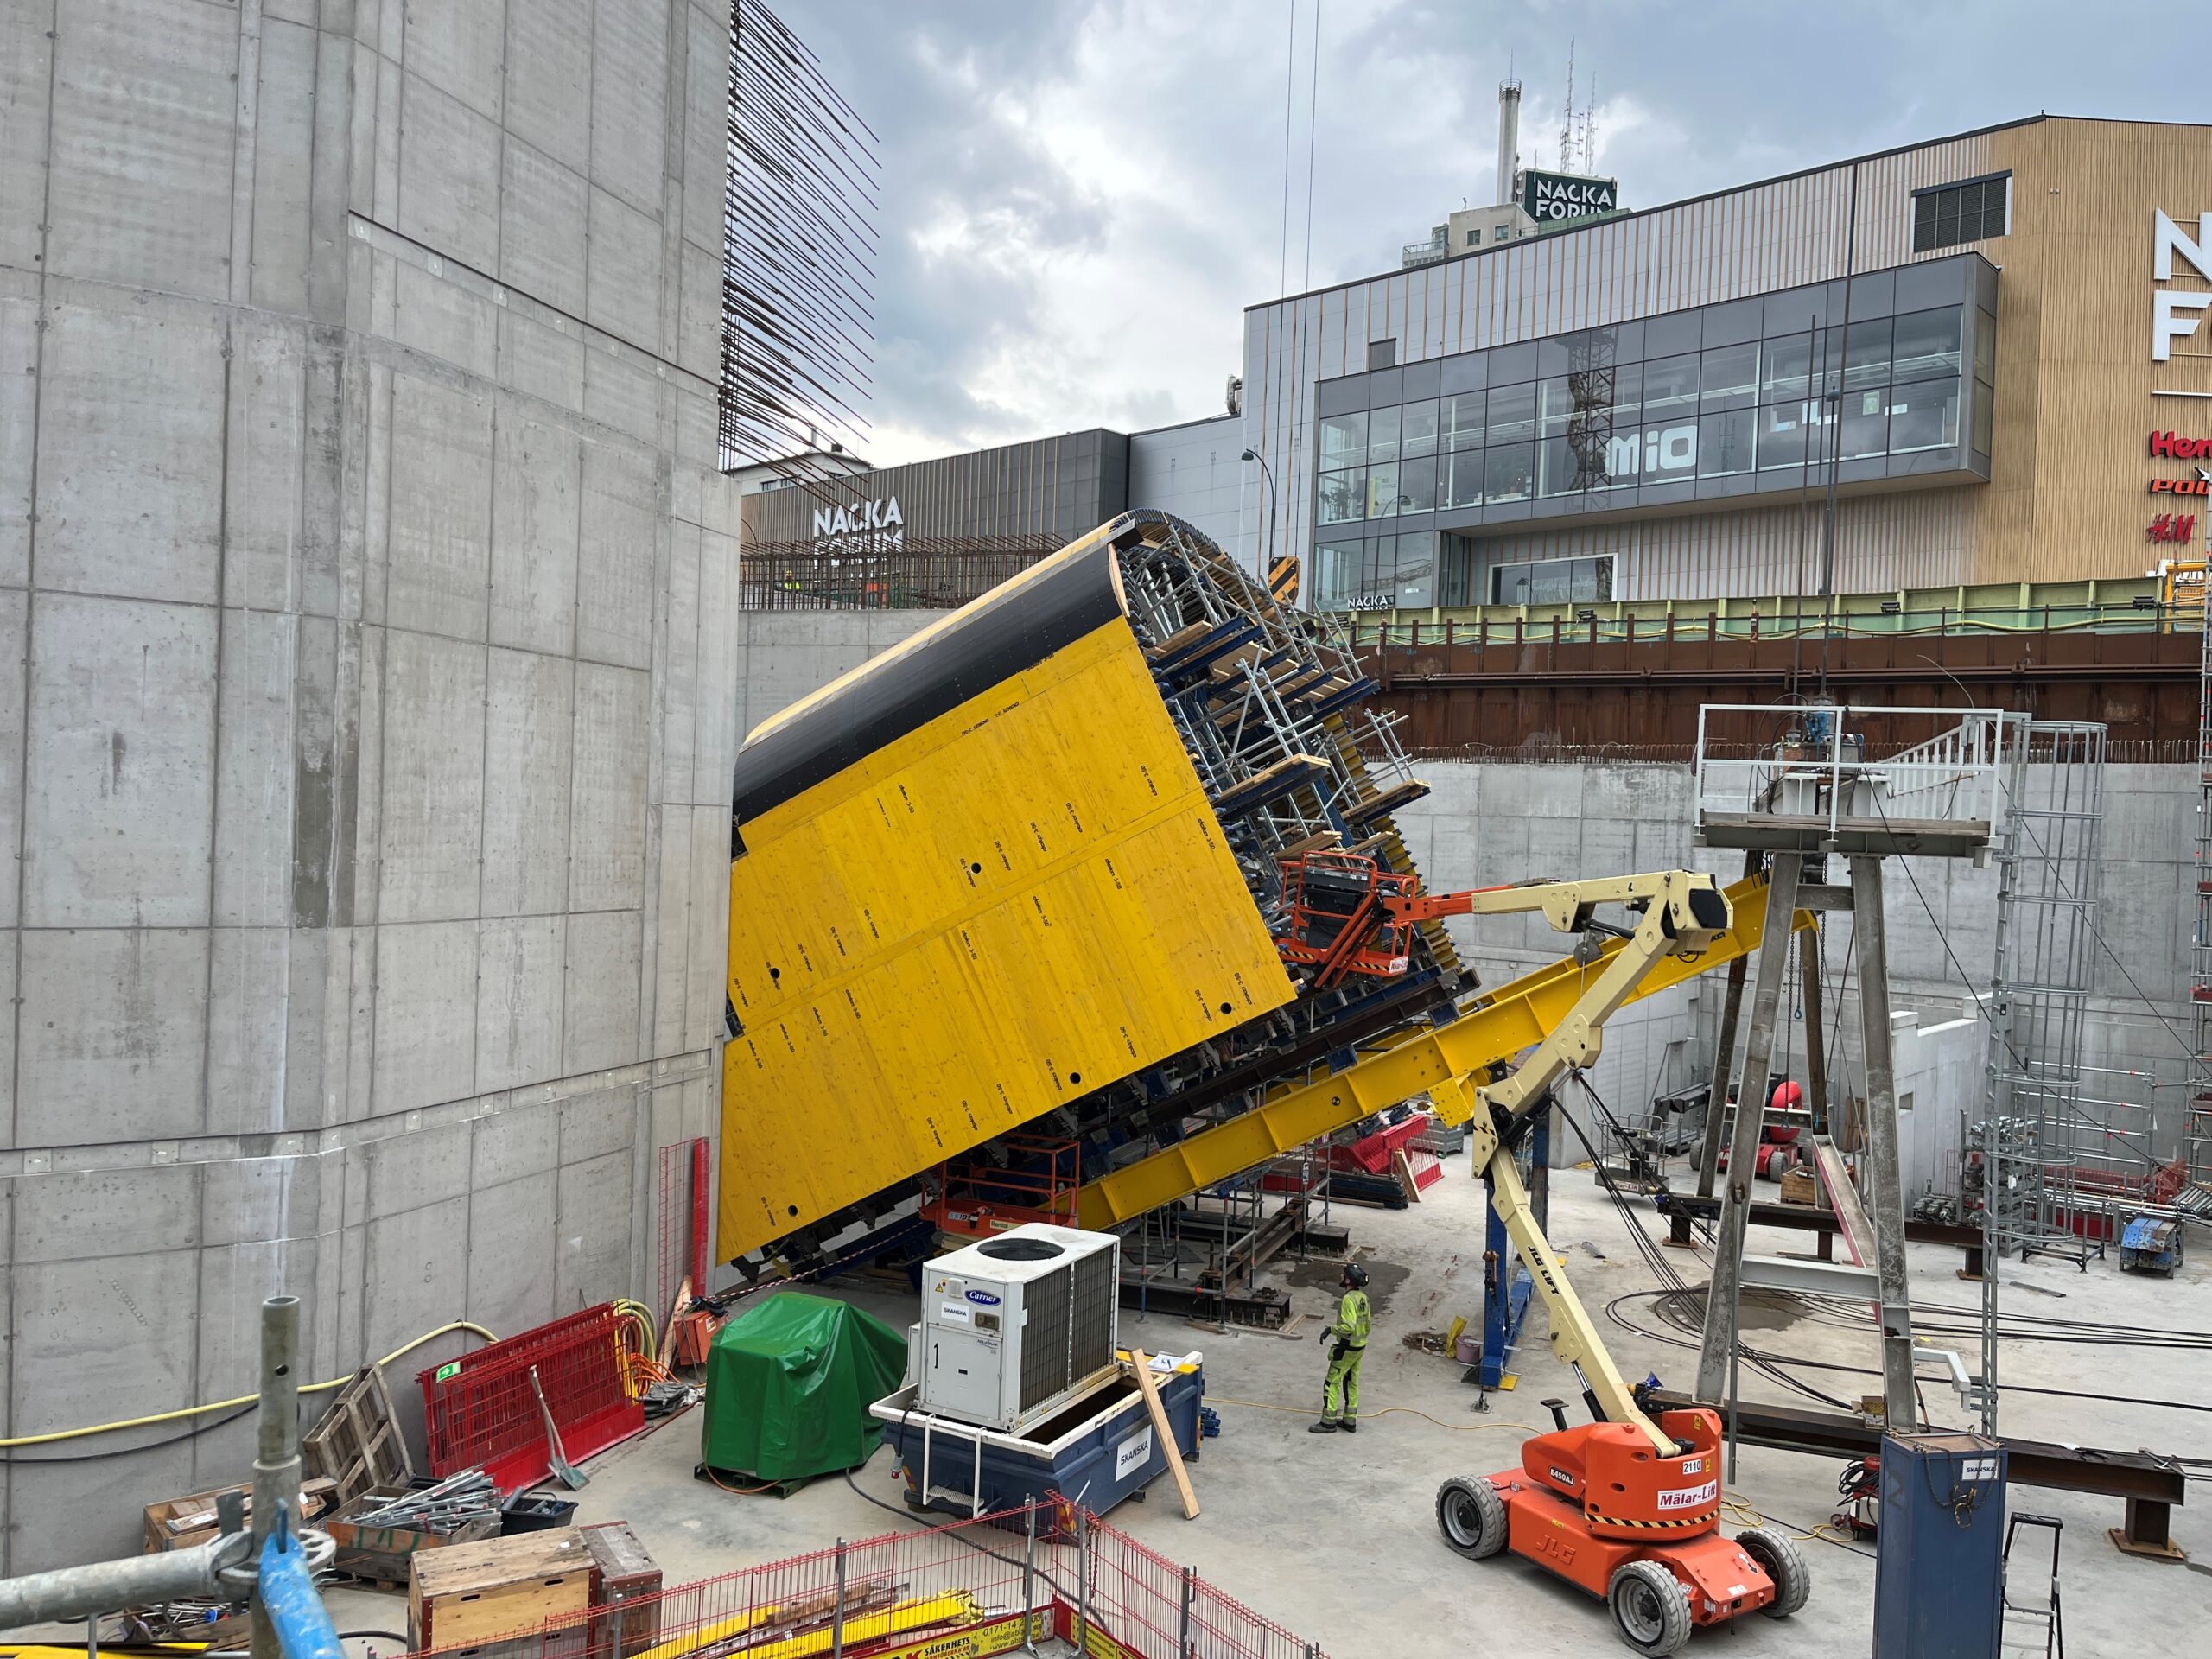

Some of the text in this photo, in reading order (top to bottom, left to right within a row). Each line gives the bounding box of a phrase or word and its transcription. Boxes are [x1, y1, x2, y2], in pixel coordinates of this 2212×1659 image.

[1536, 180, 1612, 207] NACKA
[814, 495, 904, 537] NACKA
[2147, 512, 2195, 544] H&M
[1348, 594, 1389, 607] NACKA
[1528, 1246, 1560, 1295] JLG LIFT
[969, 1291, 997, 1303] Carrier
[944, 1307, 967, 1317] SKANSKA
[933, 1343, 939, 1369] 1
[1120, 1440, 1148, 1466] SKANSKA
[1550, 1468, 1574, 1485] E450AJ
[1683, 1460, 1701, 1473] 2110
[1659, 1482, 1716, 1507] Mälar-Lift
[1535, 1535, 1577, 1565] JLG
[925, 1637, 970, 1656] SÄKERHETS
